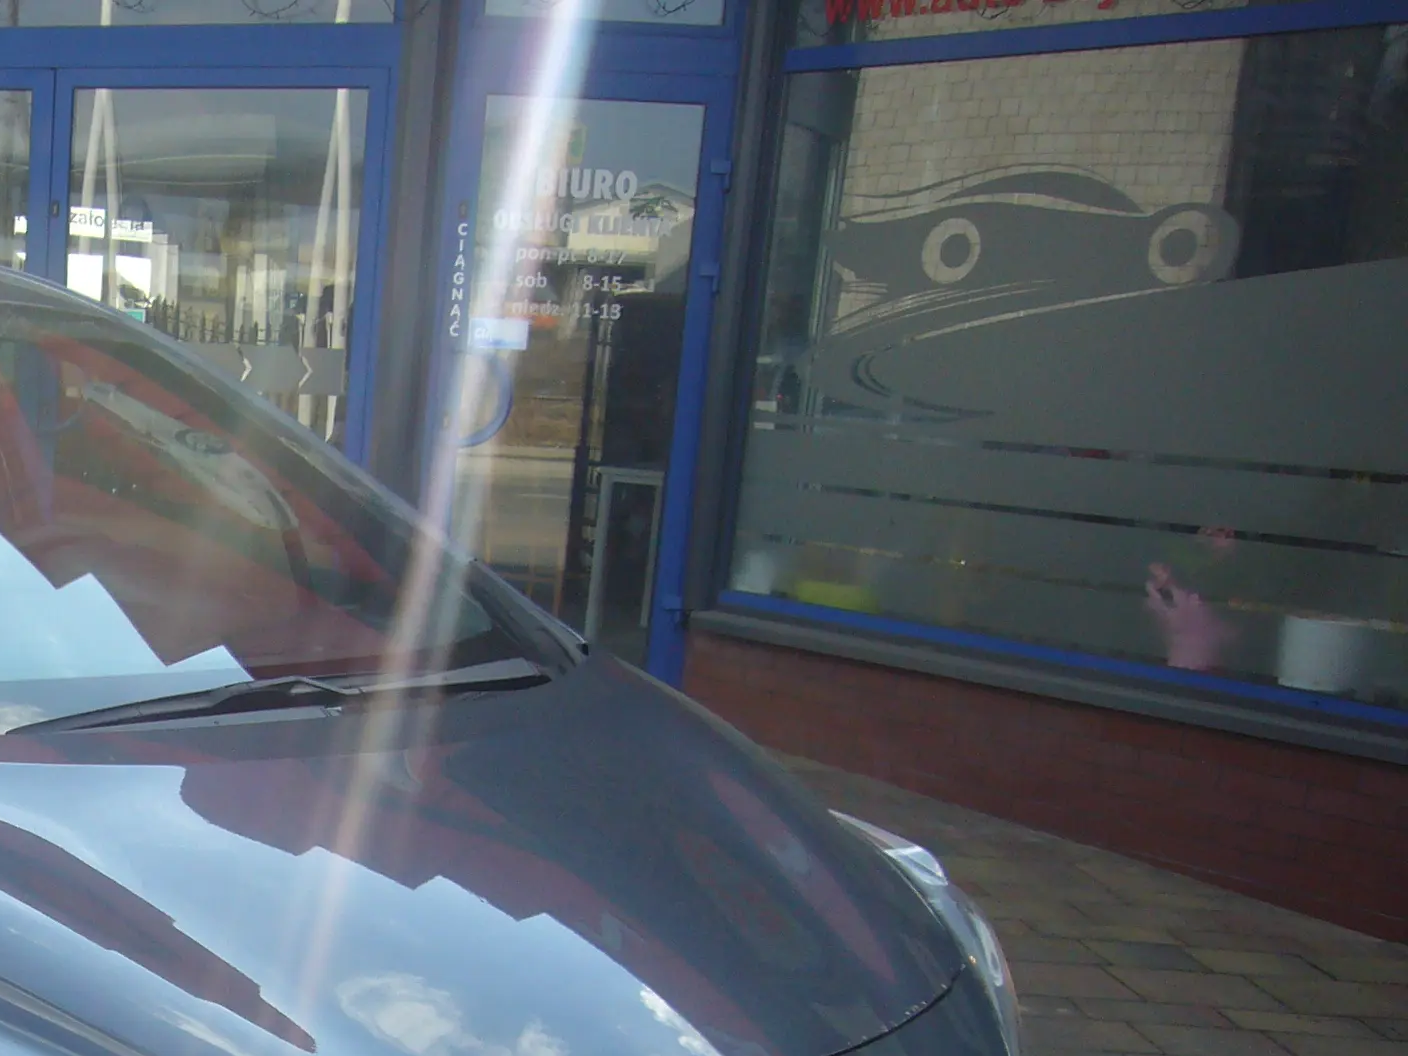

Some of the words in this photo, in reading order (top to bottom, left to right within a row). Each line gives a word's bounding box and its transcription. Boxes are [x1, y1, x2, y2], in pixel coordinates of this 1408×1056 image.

[536, 168, 638, 200] BIURO
[516, 271, 547, 289] sob
[583, 274, 623, 292] 8-15
